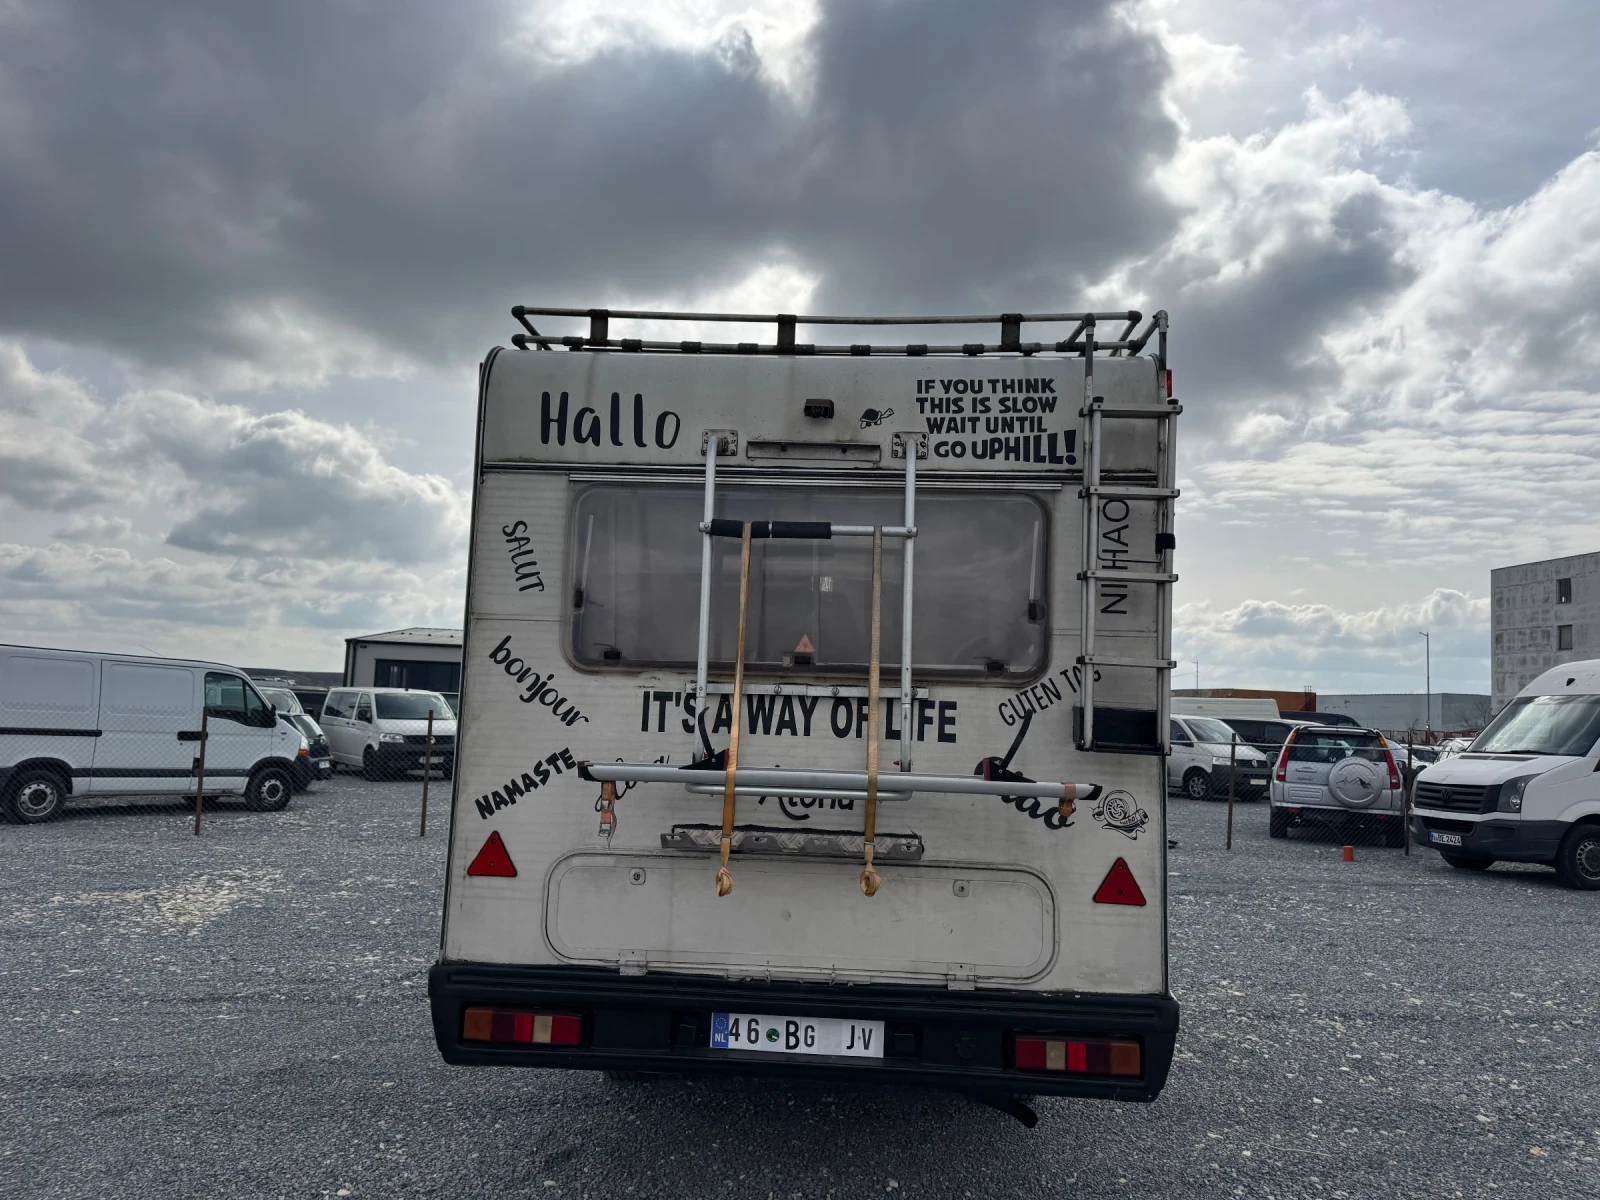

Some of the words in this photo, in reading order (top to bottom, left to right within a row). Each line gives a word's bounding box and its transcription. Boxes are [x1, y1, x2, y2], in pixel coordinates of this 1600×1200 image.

[916, 396, 965, 414] THIS
[972, 397, 992, 414] IS
[998, 396, 1058, 414] SLOW
[917, 379, 936, 394] IF
[939, 379, 983, 394] YOU
[988, 378, 1057, 394] THINK
[540, 391, 681, 450] Hallo
[926, 416, 980, 434] WAIT
[986, 416, 1047, 434] UNTIL
[934, 441, 967, 458] GO
[971, 429, 1077, 465] UPHILL!
[1101, 498, 1130, 570] HAO
[502, 520, 545, 593] SALUT
[1100, 583, 1128, 615] NI
[489, 635, 589, 727] bonjour
[998, 677, 1062, 727] GUTEN
[641, 690, 696, 733] IT'S
[711, 693, 734, 734] A
[746, 694, 817, 737] WAY
[830, 696, 869, 739] OF
[474, 746, 578, 820] NAMASTE
[714, 1032, 727, 1043] NL
[729, 1017, 760, 1044] 46
[785, 1020, 815, 1050] BG
[846, 1024, 873, 1051] JV
